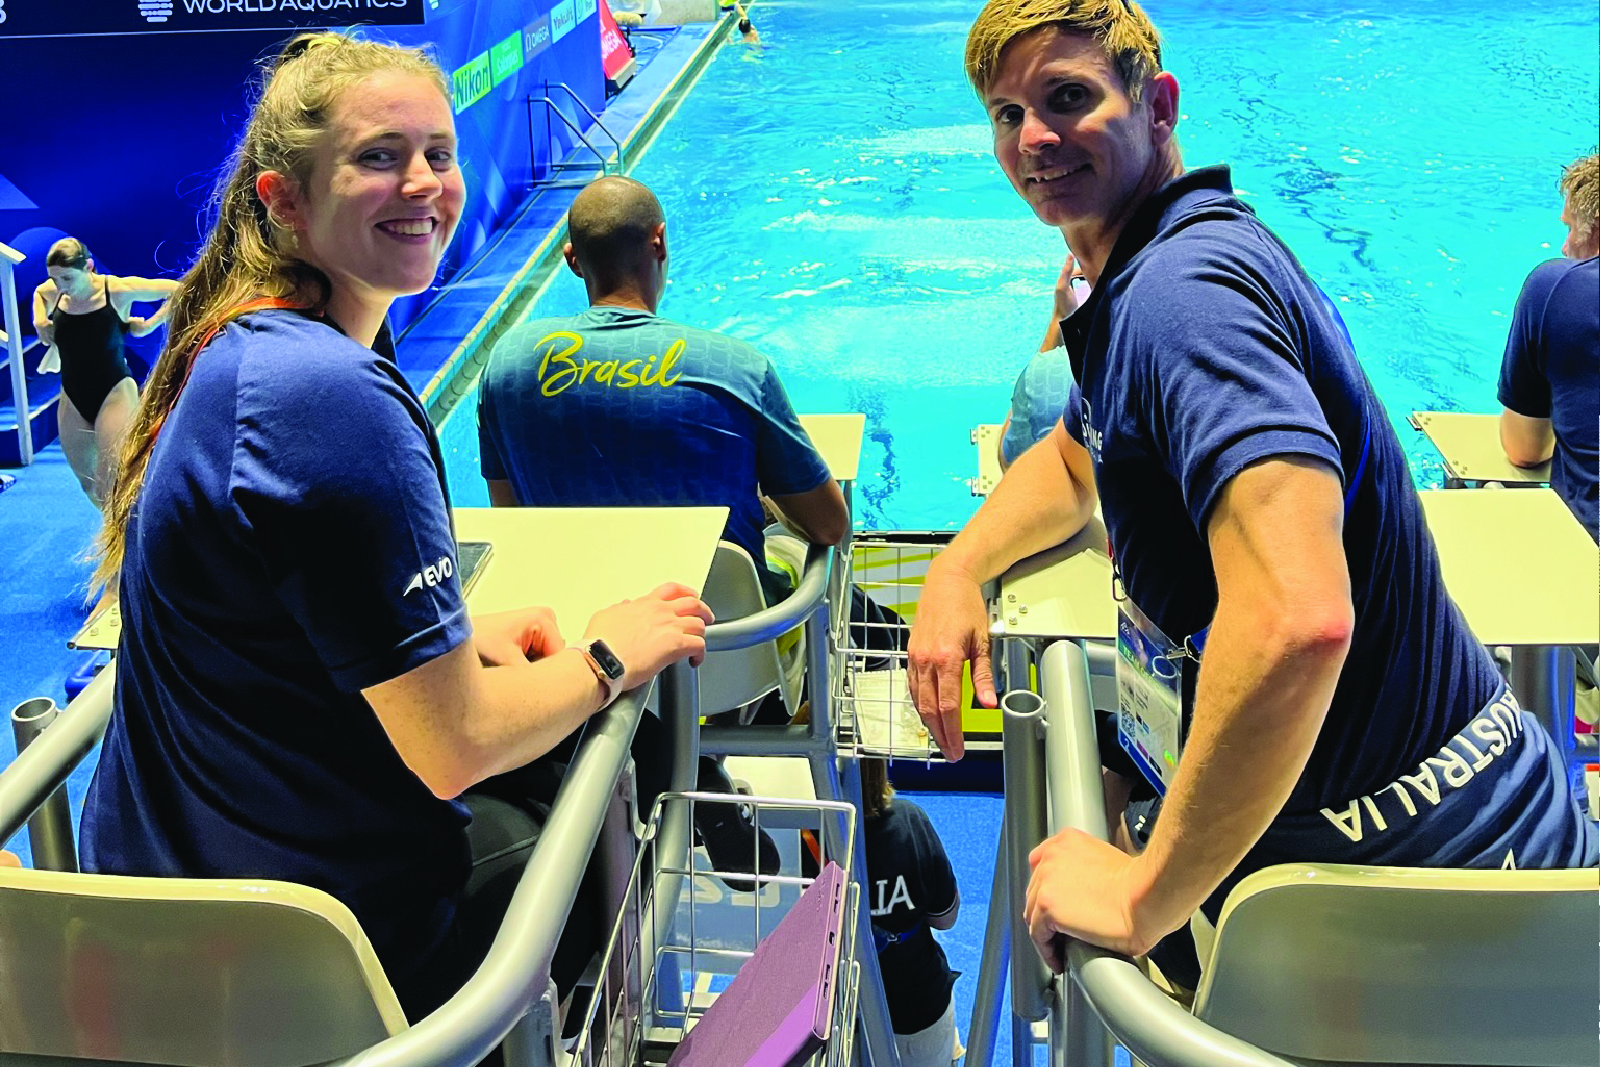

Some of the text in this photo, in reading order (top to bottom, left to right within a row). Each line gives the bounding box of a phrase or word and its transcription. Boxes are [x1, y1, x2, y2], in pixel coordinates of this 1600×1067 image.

[532, 26, 550, 48] OMEGA
[455, 64, 490, 106] Nikon
[533, 330, 686, 397] Brasil
[1320, 690, 1523, 842] AUSTRALIA
